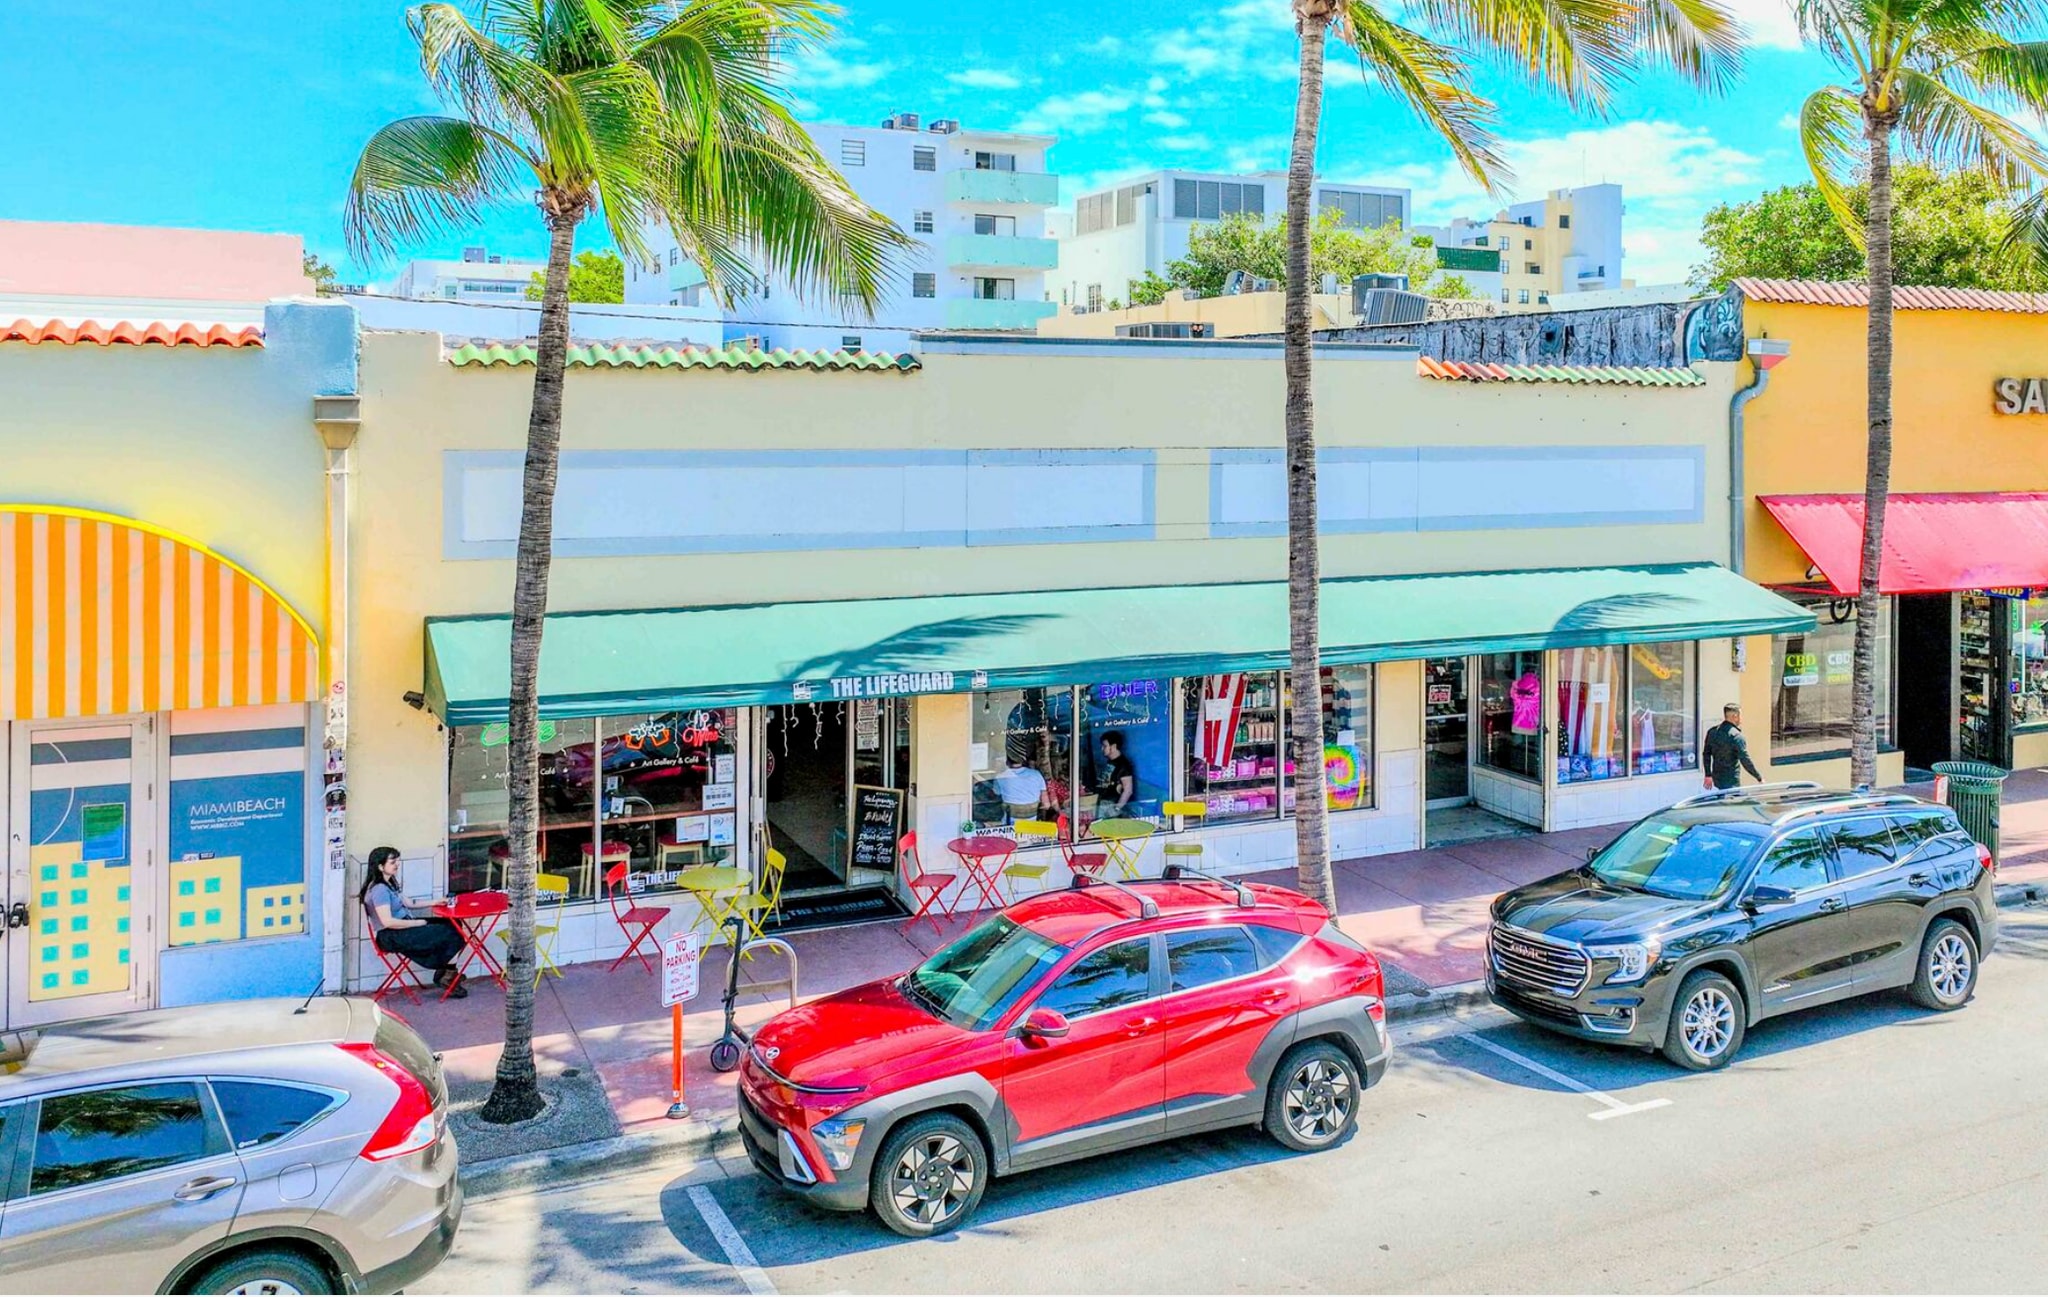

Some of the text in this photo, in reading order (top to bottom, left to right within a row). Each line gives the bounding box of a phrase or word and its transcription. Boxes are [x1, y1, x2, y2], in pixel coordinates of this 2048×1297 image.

[1997, 378, 2048, 415] SA
[1990, 587, 2024, 597] SHOP
[1786, 653, 1817, 667] CBD
[831, 672, 954, 698] THE LIFEGUARD
[1100, 680, 1157, 699] DINER
[1113, 718, 1132, 727] Gallery
[682, 727, 719, 747] Wine
[1010, 727, 1029, 737] Gallery
[653, 757, 677, 767] Gallery
[190, 797, 286, 817] MIAMIBEACH
[190, 812, 284, 826] Economic Development Department
[645, 873, 665, 886] THE
[676, 940, 687, 953] NO
[1510, 942, 1548, 962] GMC
[666, 950, 696, 968] PARKING
